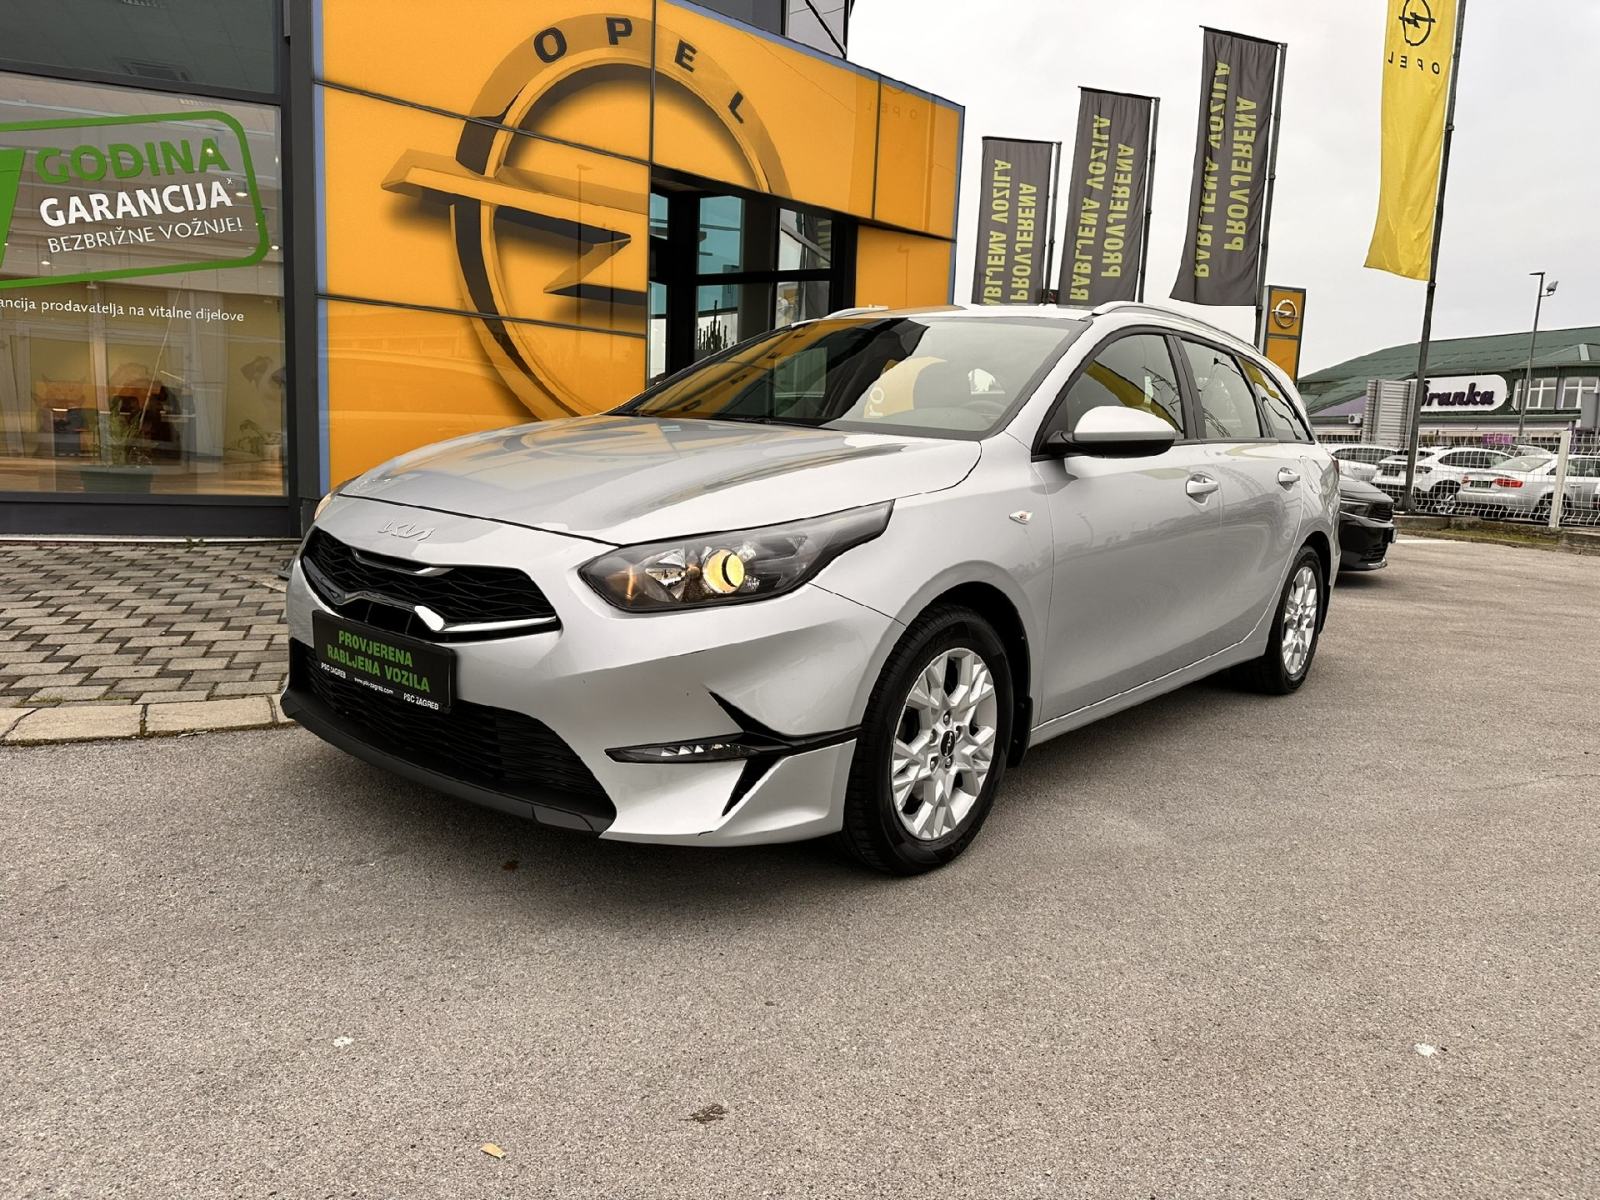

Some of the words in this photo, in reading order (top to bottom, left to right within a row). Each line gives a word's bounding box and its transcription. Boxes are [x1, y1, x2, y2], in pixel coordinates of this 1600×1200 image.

[534, 16, 746, 124] OPEL
[35, 138, 230, 184] GODINA
[48, 227, 156, 253] BEZBRIŽNE
[158, 216, 243, 240] VOŽNJE!
[41, 301, 124, 318] prodavatelja
[129, 306, 145, 316] na
[149, 305, 192, 319] vitalne
[196, 308, 245, 322] dijelove
[338, 630, 413, 668] PROVJERENA
[327, 646, 381, 677] RABLJENA
[384, 664, 430, 693] VOZILA
[403, 692, 415, 703] PSC
[415, 696, 439, 710] ZAGREB
